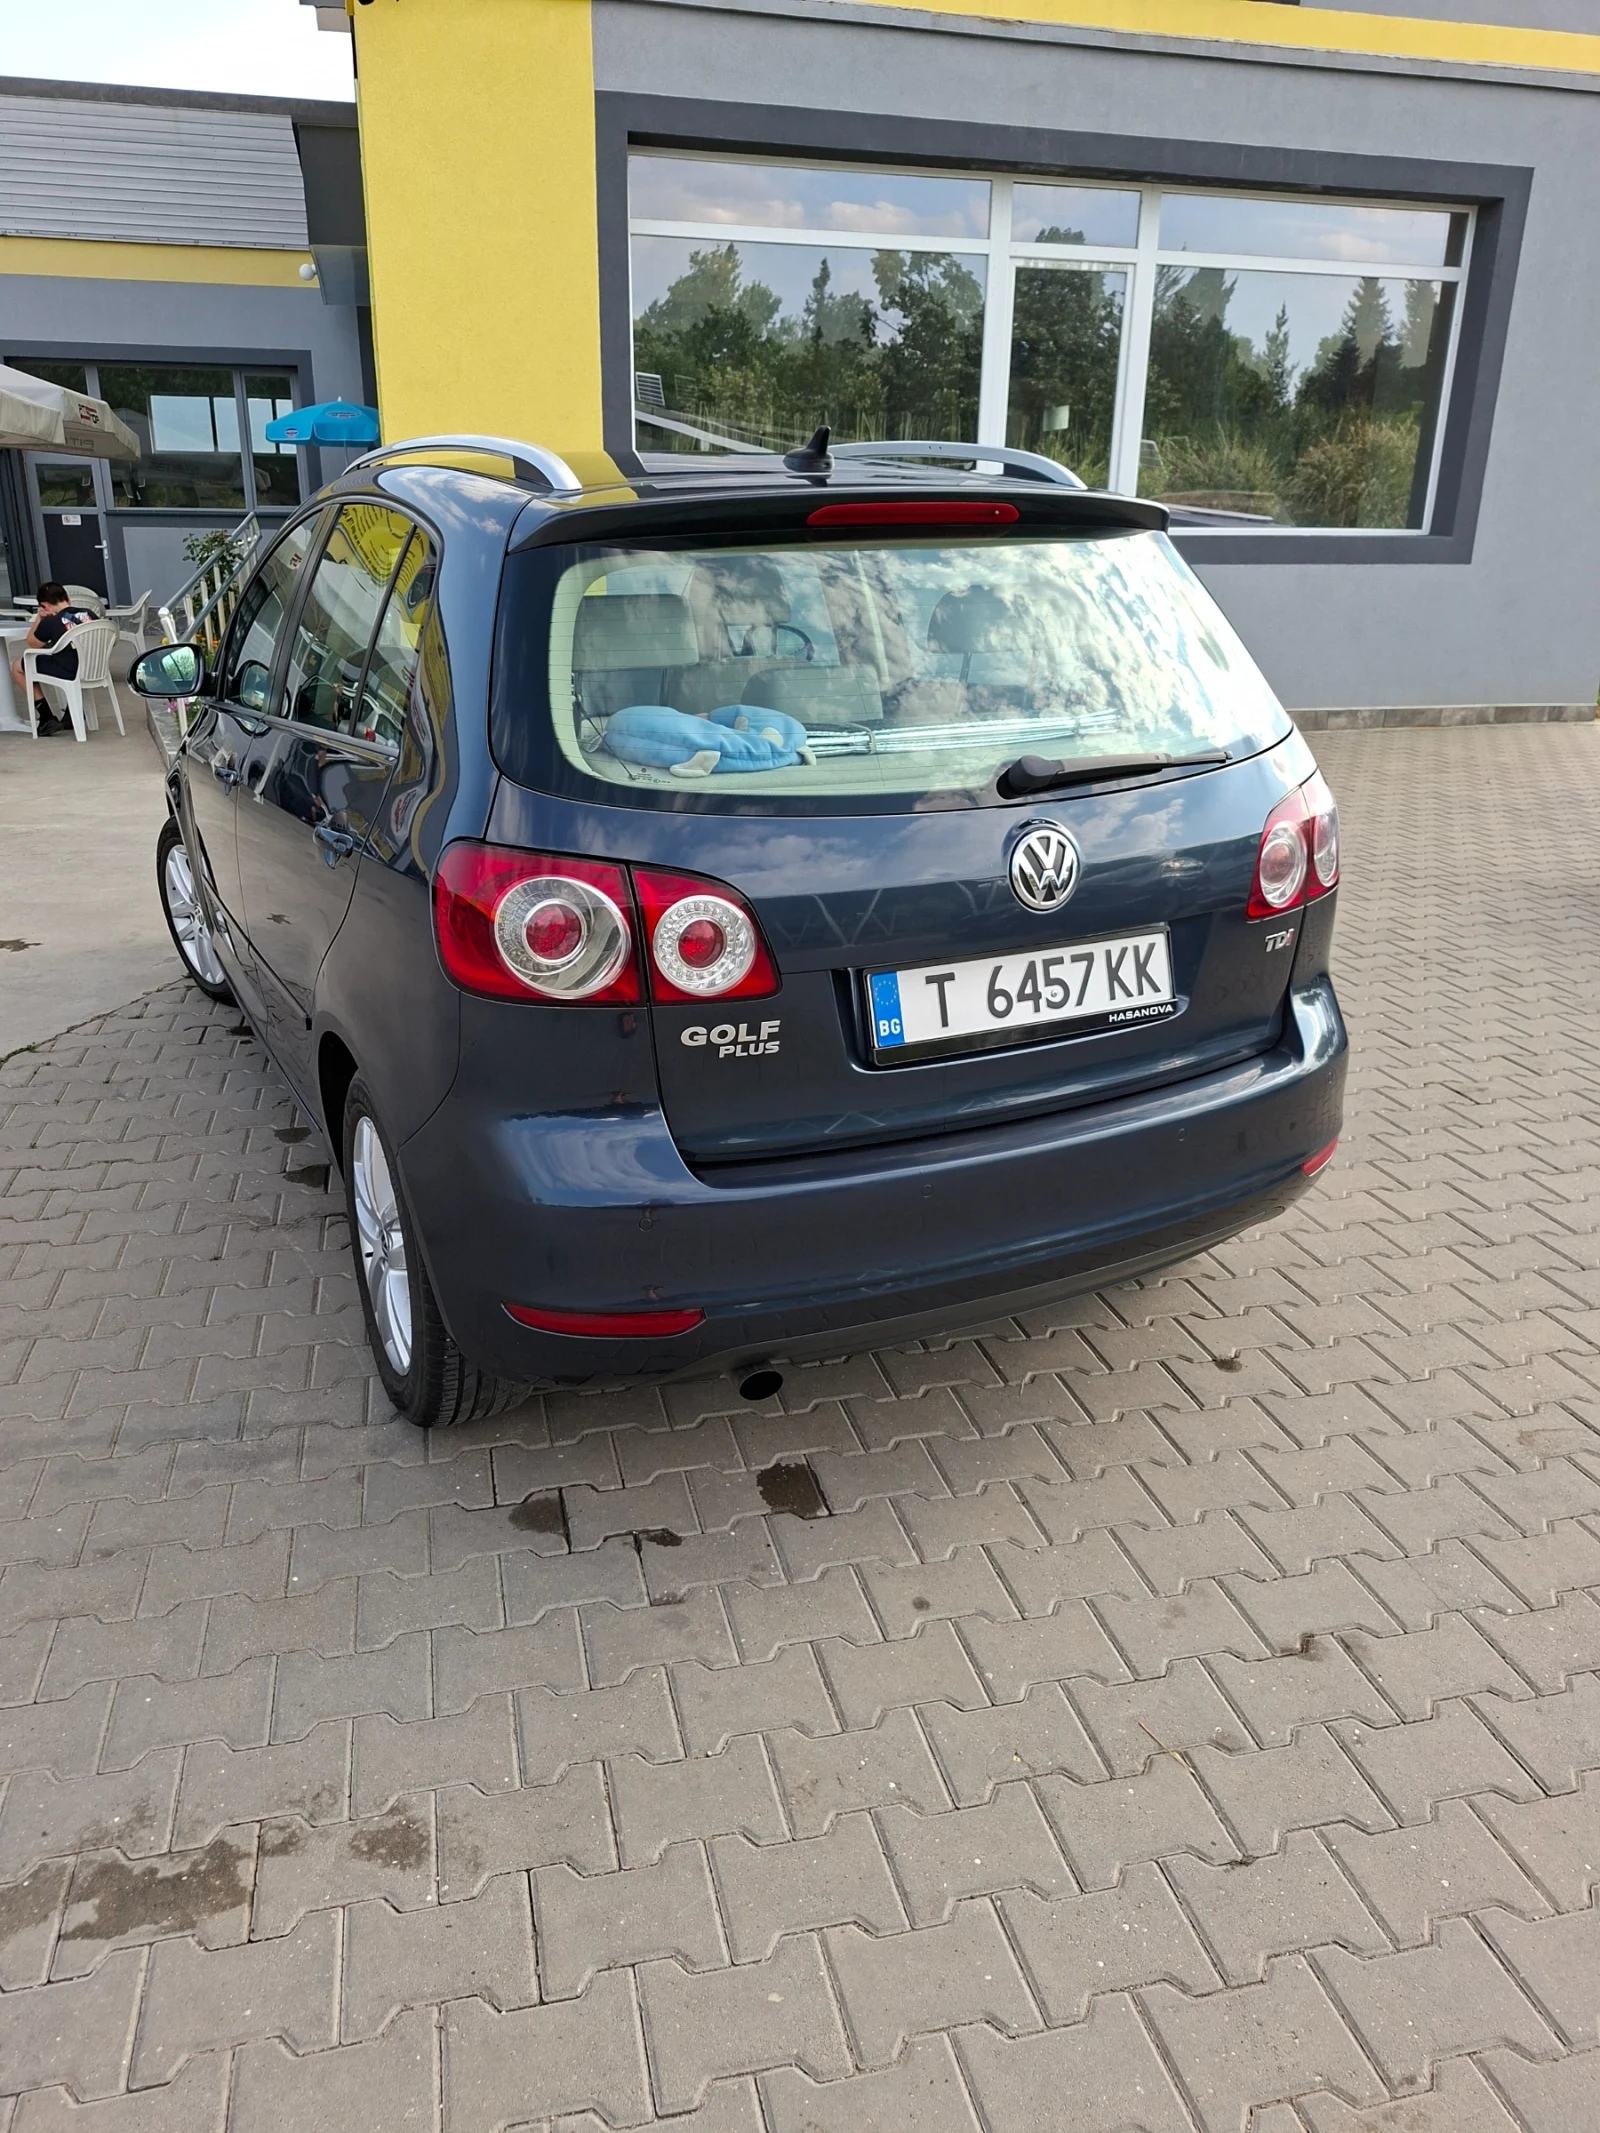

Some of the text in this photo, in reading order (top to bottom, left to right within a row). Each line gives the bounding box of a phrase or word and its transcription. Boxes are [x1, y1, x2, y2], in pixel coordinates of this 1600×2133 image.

[1010, 826, 1079, 911] VW
[924, 942, 1162, 1028] T 6457 KK
[1108, 1002, 1174, 1023] HASANOVA
[680, 1019, 781, 1047] GOLF
[879, 1018, 901, 1037] BG
[718, 1041, 780, 1058] PLUS
